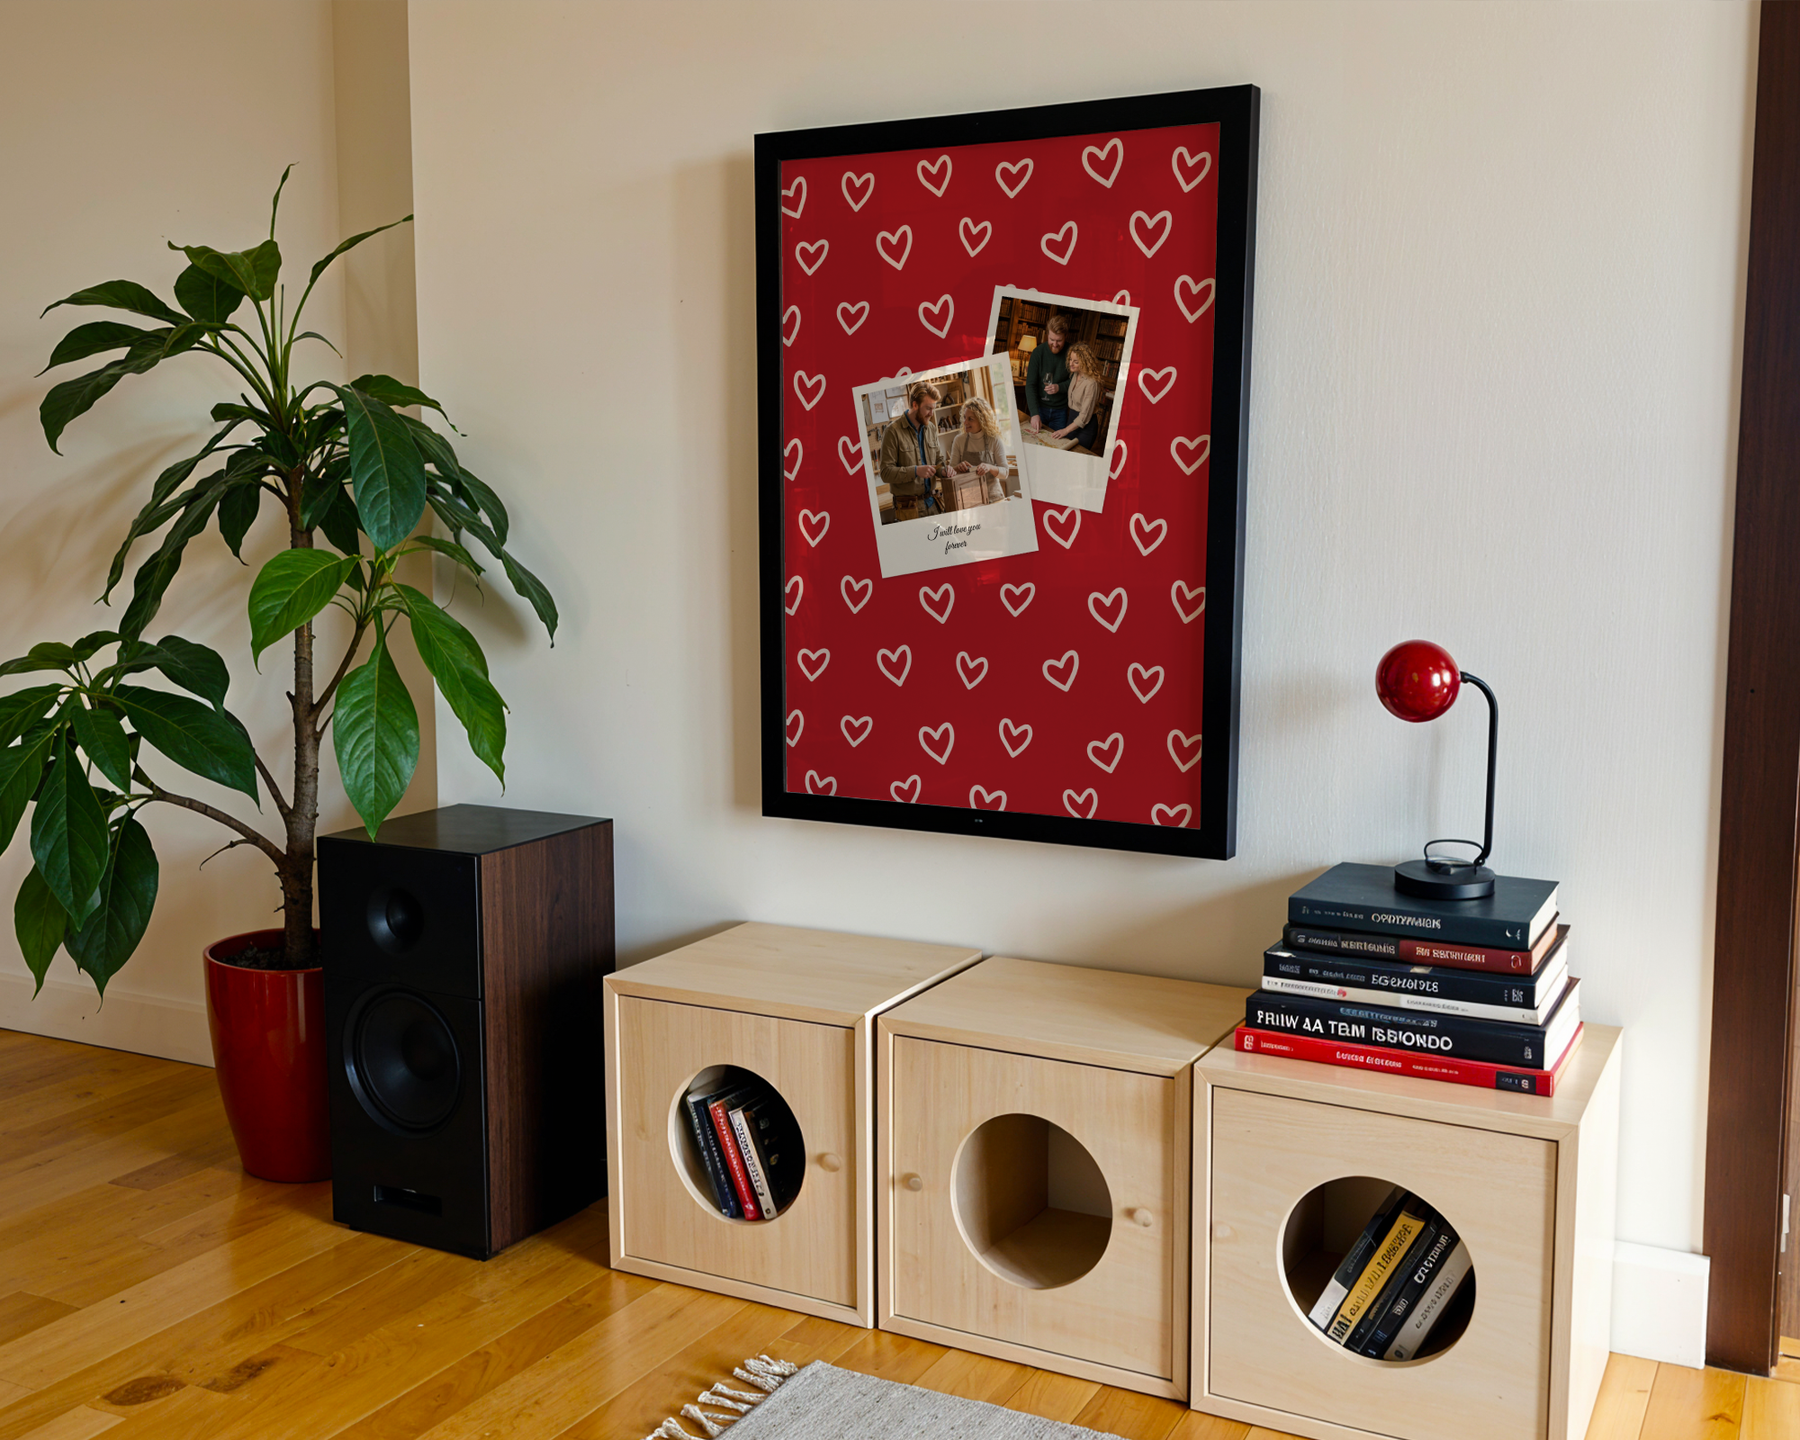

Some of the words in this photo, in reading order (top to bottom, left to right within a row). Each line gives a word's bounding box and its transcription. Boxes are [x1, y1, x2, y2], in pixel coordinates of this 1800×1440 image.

[927, 525, 940, 541] I
[940, 526, 953, 537] will
[954, 525, 967, 535] love
[966, 524, 981, 536] you
[945, 540, 967, 555] forever
